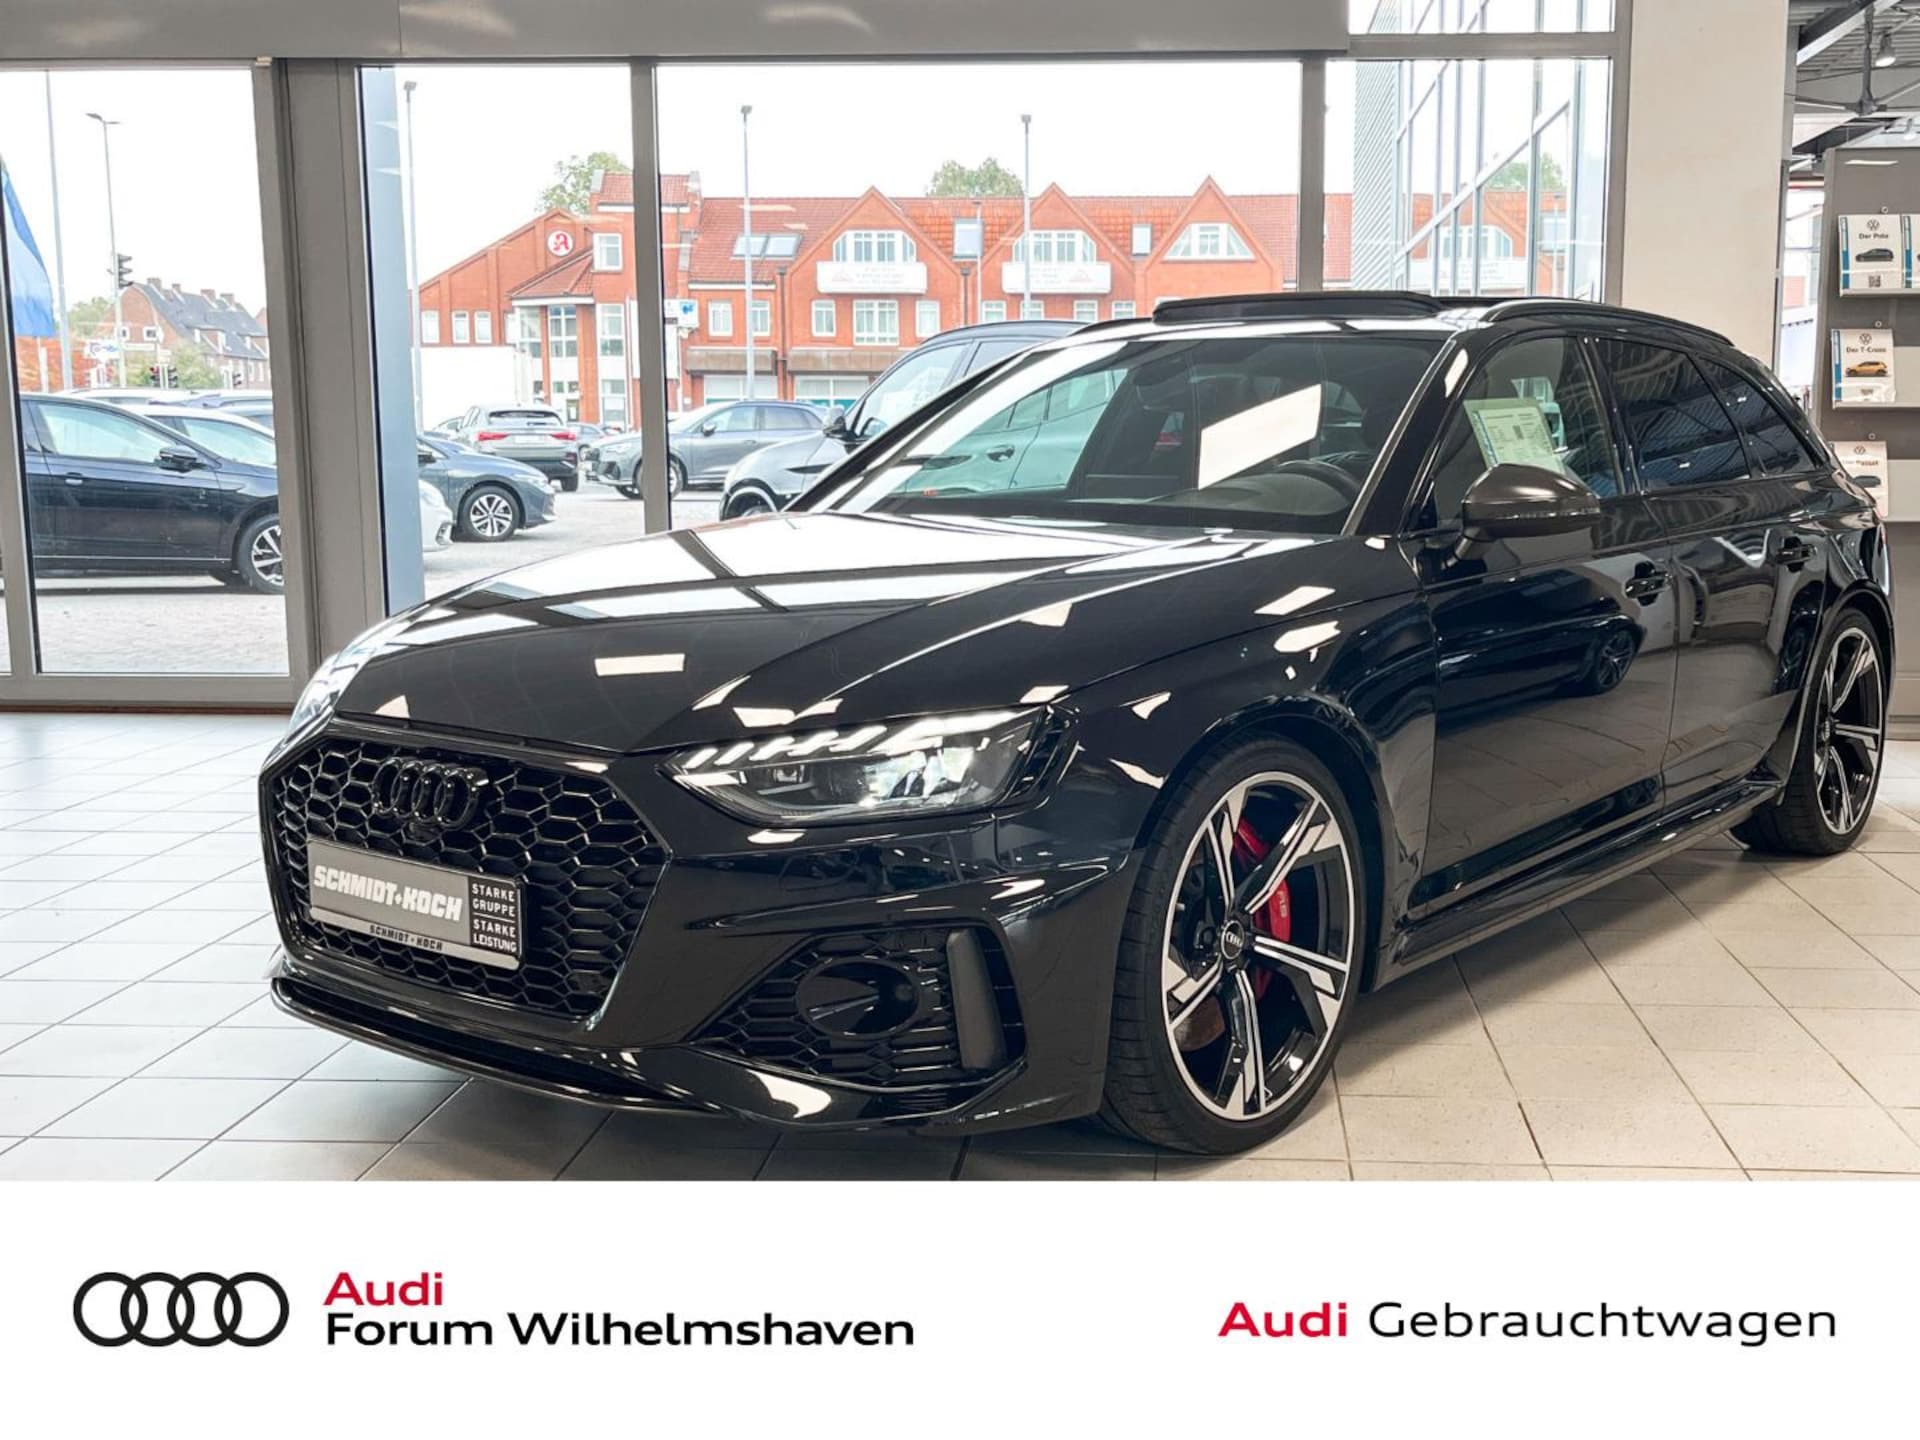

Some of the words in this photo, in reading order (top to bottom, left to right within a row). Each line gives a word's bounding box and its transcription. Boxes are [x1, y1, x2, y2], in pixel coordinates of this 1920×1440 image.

[1858, 232, 1871, 240] Der
[471, 883, 515, 902] STARKE
[472, 898, 516, 917] GRUPPE
[369, 924, 409, 942] SCHMIDT
[416, 937, 443, 951] KOCH
[473, 919, 516, 938] STARKE
[473, 932, 517, 952] LEISTUNG
